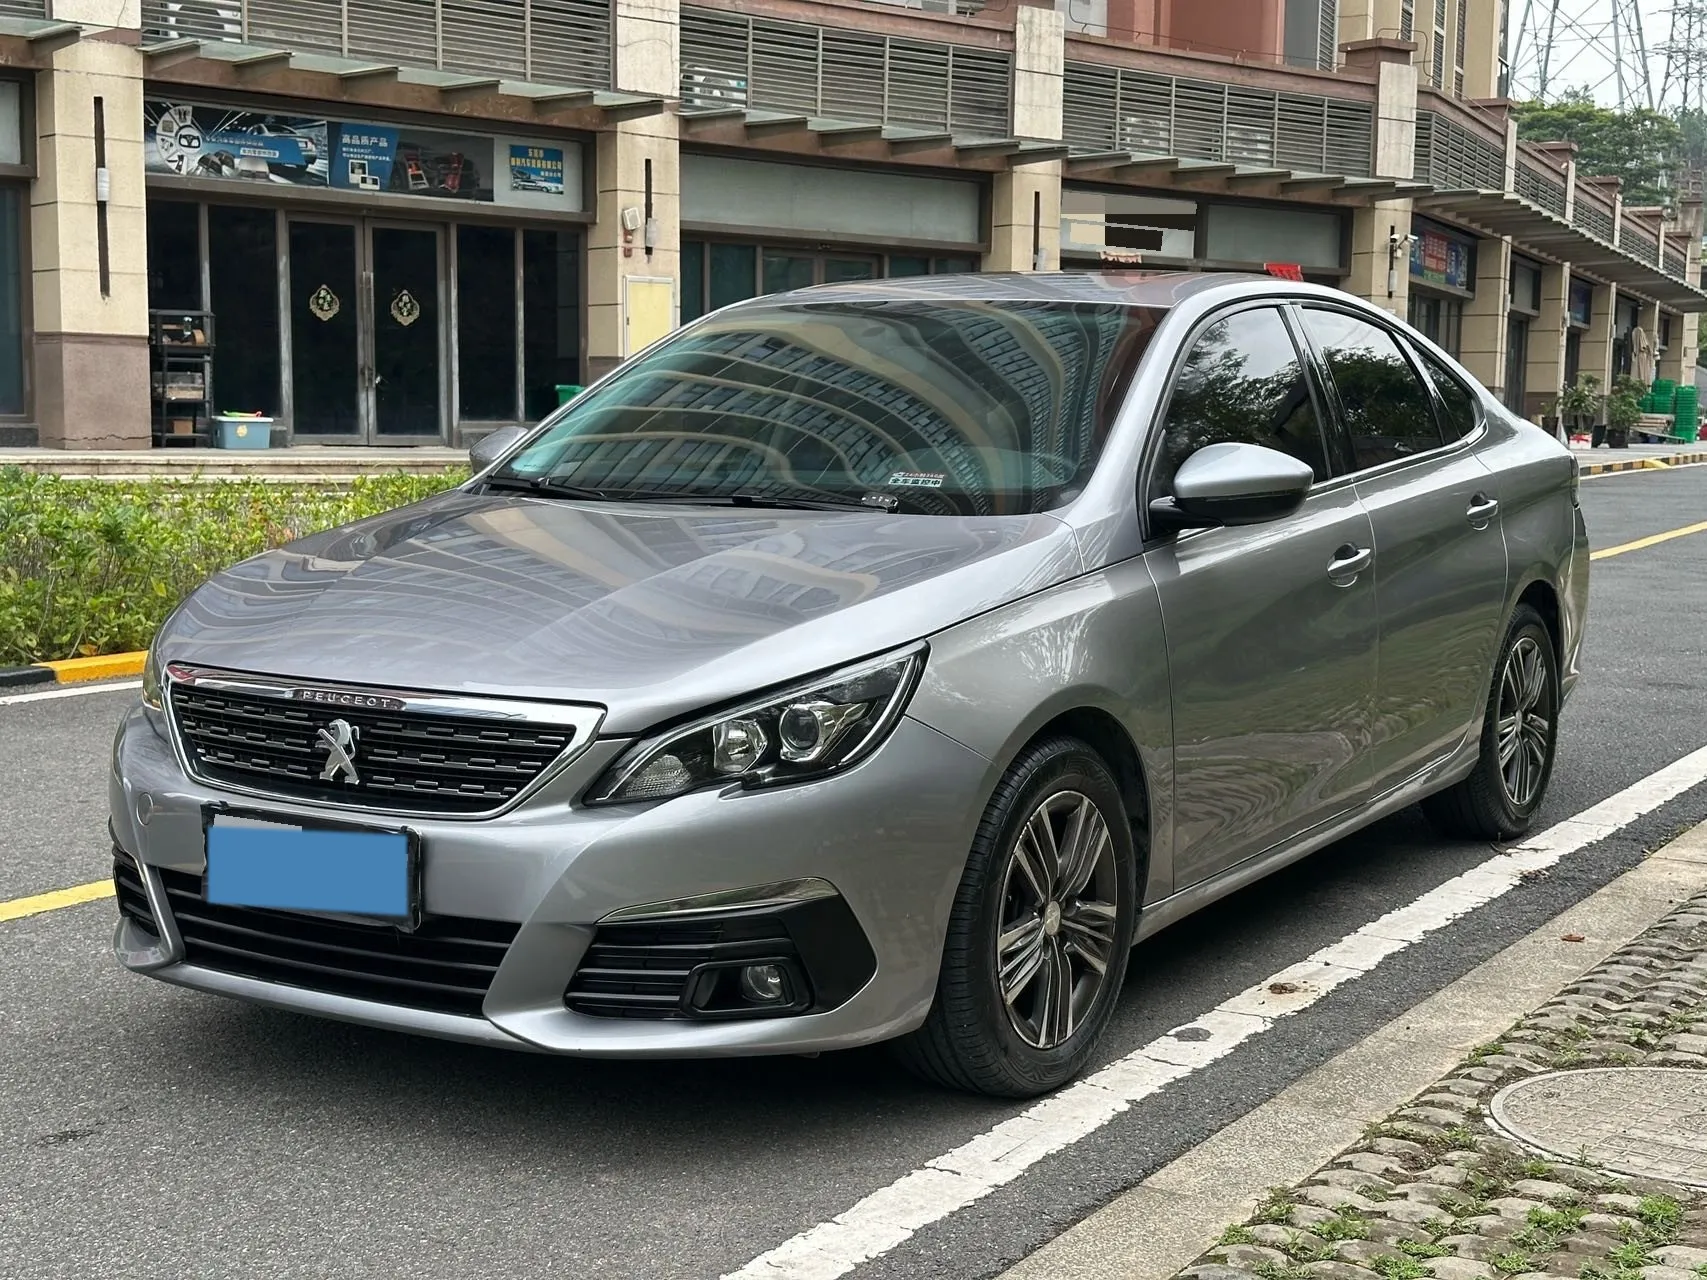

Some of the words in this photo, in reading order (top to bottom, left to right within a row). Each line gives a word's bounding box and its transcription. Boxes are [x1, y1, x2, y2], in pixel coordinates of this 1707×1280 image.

[342, 135, 388, 147] 高品质产品
[890, 477, 941, 486] 全车监控中
[303, 691, 391, 708] PEUGEOT
